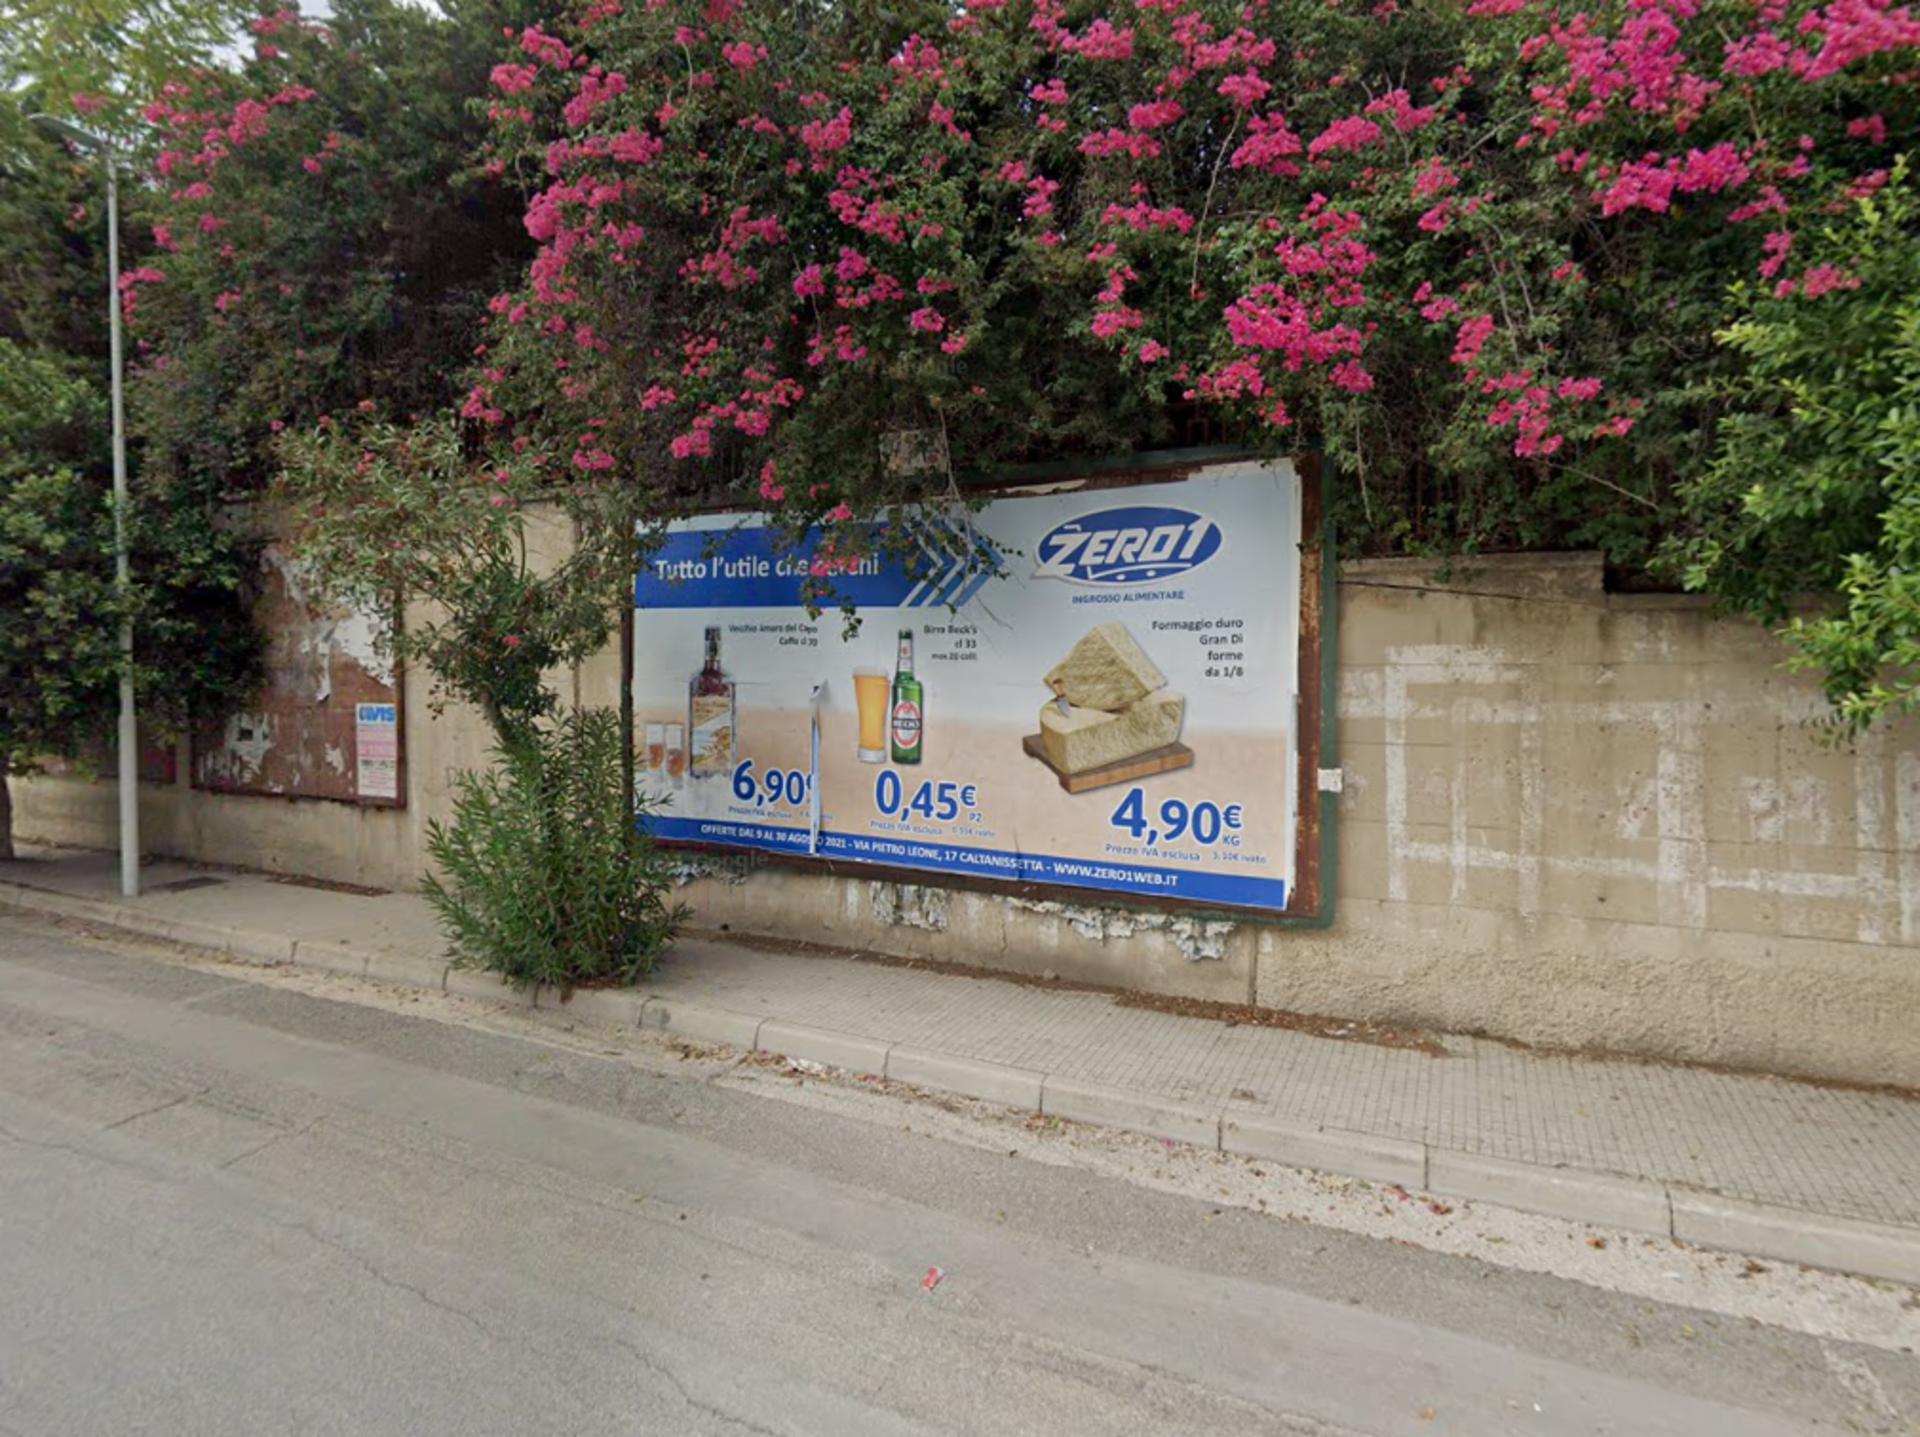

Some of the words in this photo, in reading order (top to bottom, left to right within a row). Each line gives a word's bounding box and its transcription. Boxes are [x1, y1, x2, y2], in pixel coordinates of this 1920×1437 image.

[656, 559, 707, 580] Tutto
[712, 555, 770, 579] l'utile
[1072, 593, 1122, 604] INGROSSO
[1123, 590, 1185, 603] ALIMENTARE
[1152, 619, 1213, 631] Formaggio
[1215, 618, 1244, 629] duro
[1199, 634, 1228, 646] Gran
[1208, 649, 1244, 661] forme
[1205, 666, 1220, 678] da
[733, 760, 813, 807] 6,90
[875, 769, 977, 822] 0,45€
[1111, 788, 1243, 846] 4,90€
[1223, 835, 1241, 846] KG
[1105, 843, 1138, 855] Prezzo
[1141, 847, 1159, 857] IVA
[1161, 851, 1200, 862] esclusa
[825, 836, 847, 849] 2021
[854, 839, 870, 850] VIA
[872, 841, 905, 856] PIETRO
[945, 849, 956, 861] 17
[1053, 862, 1179, 887] WWW.ZERO1WEB.IT
